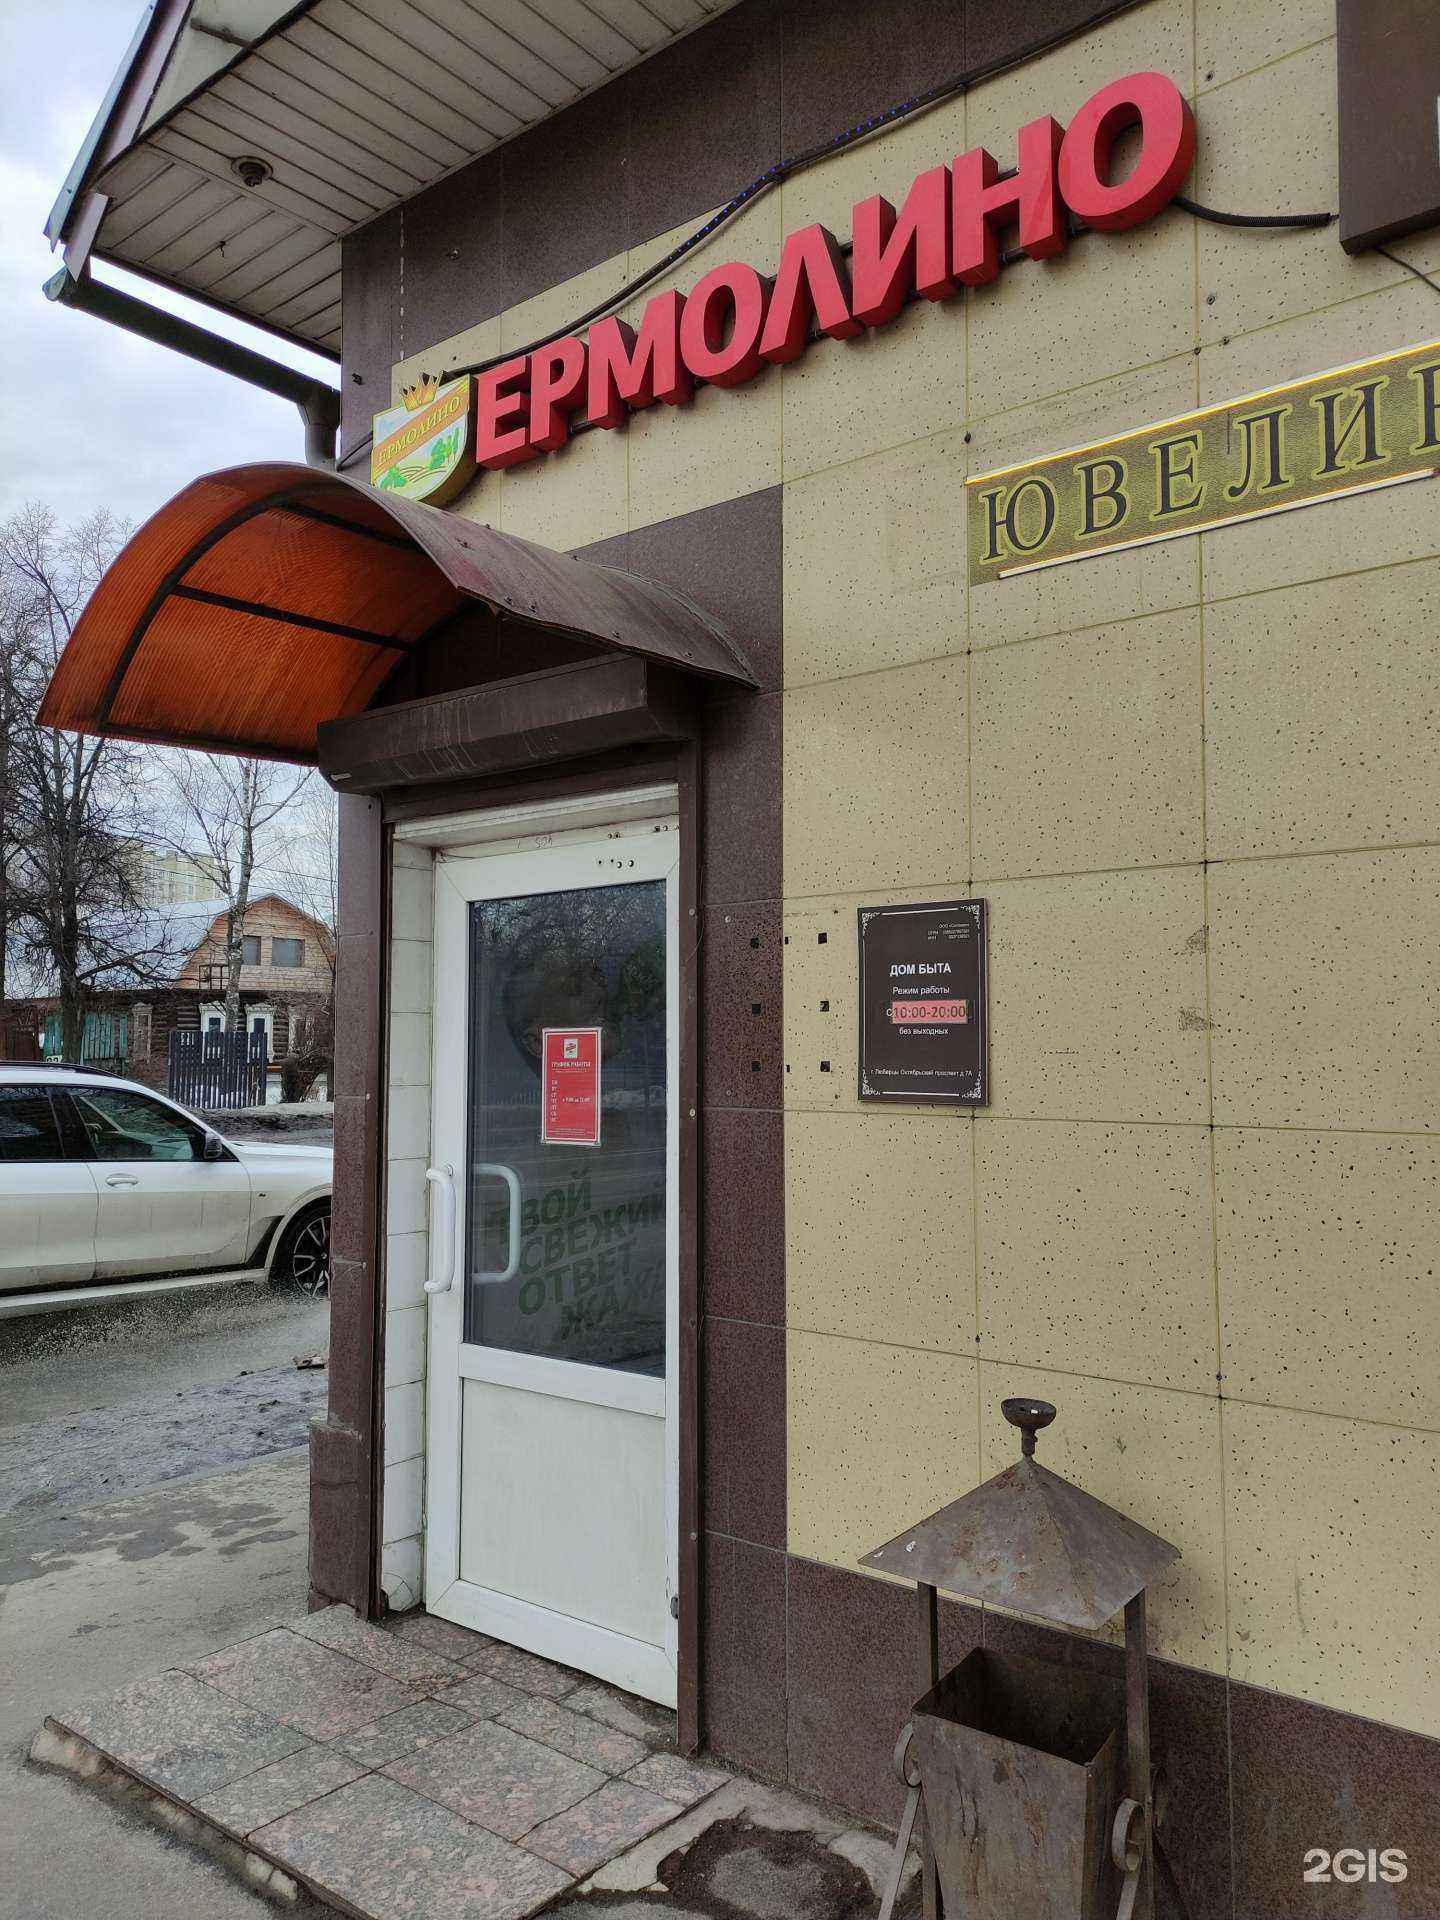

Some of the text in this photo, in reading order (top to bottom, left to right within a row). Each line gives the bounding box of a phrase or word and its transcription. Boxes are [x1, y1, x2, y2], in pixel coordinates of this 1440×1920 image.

[475, 71, 1194, 470] ЕРМОЛИНО
[889, 962, 952, 977] ДОМ БЫТА
[892, 985, 950, 995] Режим работы
[894, 1005, 966, 1018] 10:00-20:00
[899, 1026, 949, 1036] без выходных
